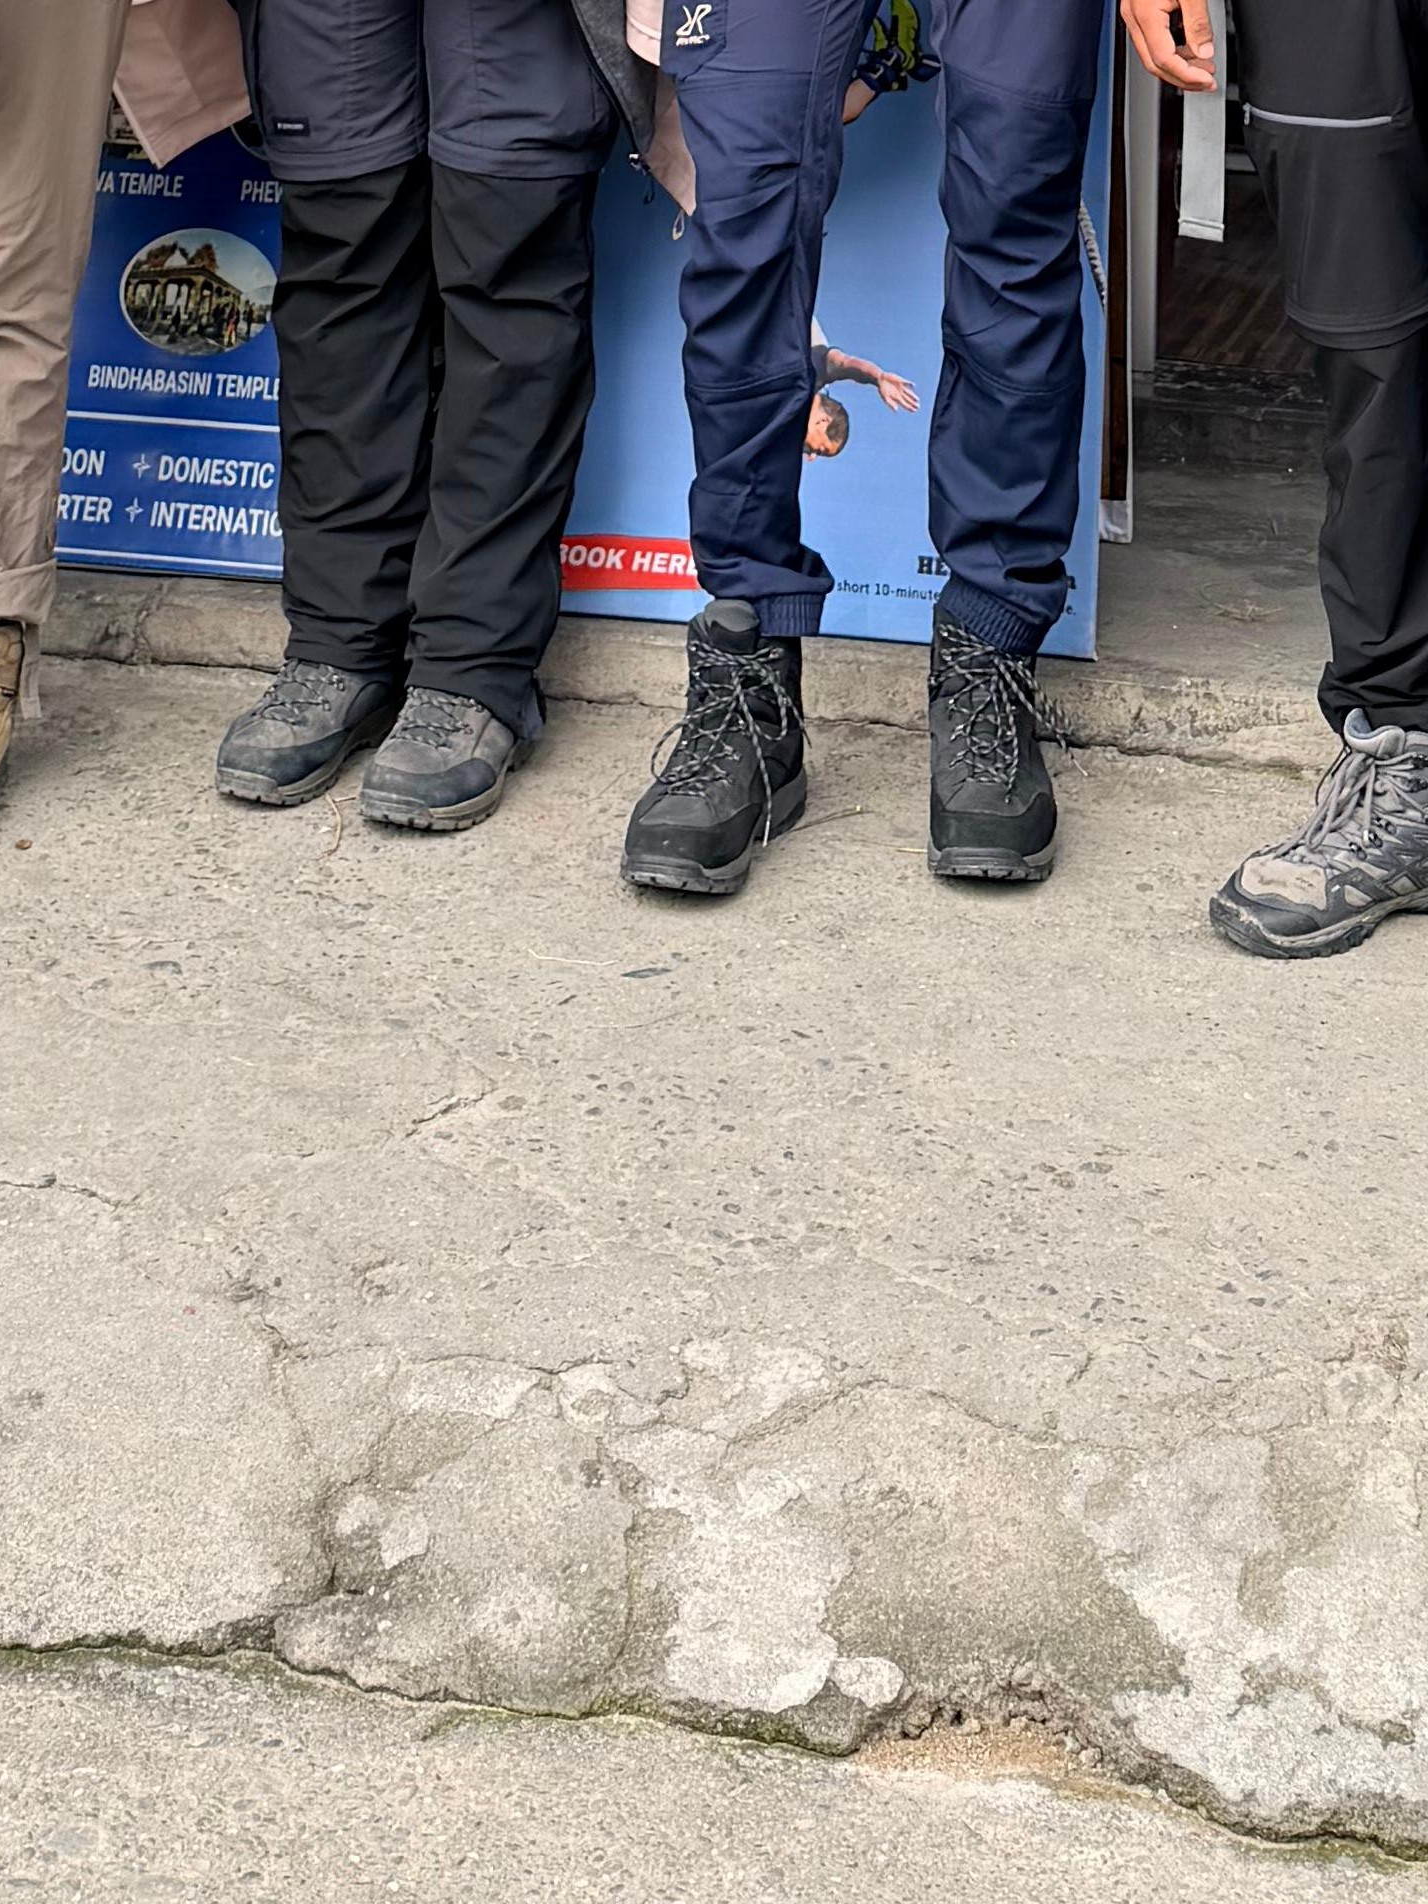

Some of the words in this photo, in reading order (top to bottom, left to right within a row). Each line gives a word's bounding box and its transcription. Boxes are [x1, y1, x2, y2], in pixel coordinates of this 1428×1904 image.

[119, 172, 184, 197] TEMPLE
[87, 364, 212, 395] BINDHABASINI
[216, 373, 280, 401] TEMPLE
[157, 455, 275, 489] DOMESTIC
[57, 494, 113, 523] RTER
[150, 501, 283, 537] INTERNATIO
[560, 543, 626, 570] BOOK
[837, 580, 870, 595] short
